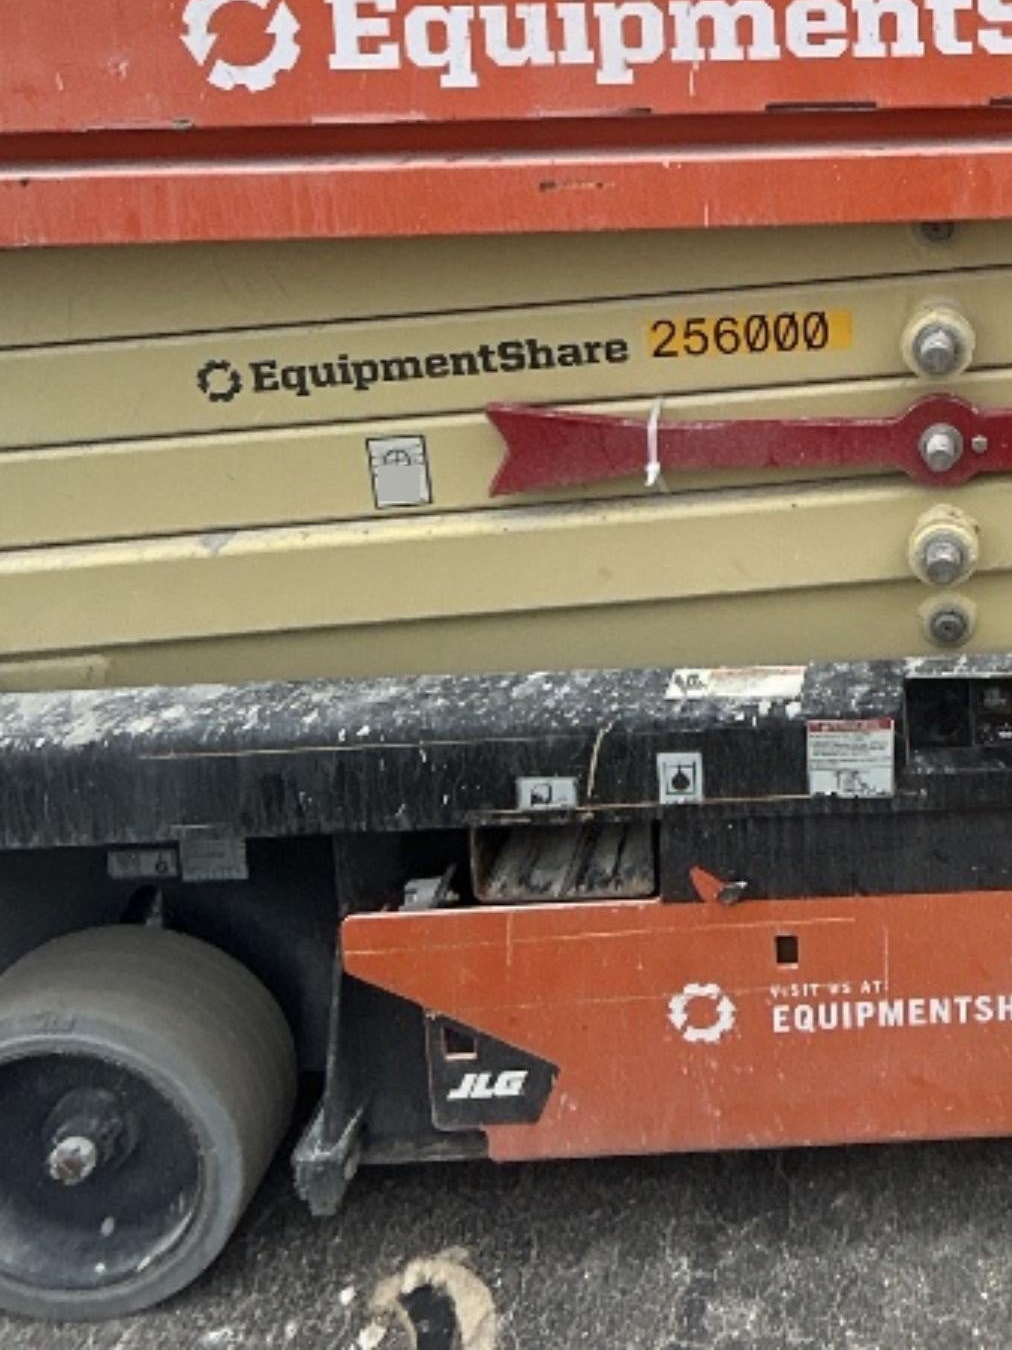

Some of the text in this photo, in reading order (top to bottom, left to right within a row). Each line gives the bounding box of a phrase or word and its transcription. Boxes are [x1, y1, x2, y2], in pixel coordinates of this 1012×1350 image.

[249, 310, 830, 397] EquipmentShare 256000
[447, 1070, 528, 1100] JLG
